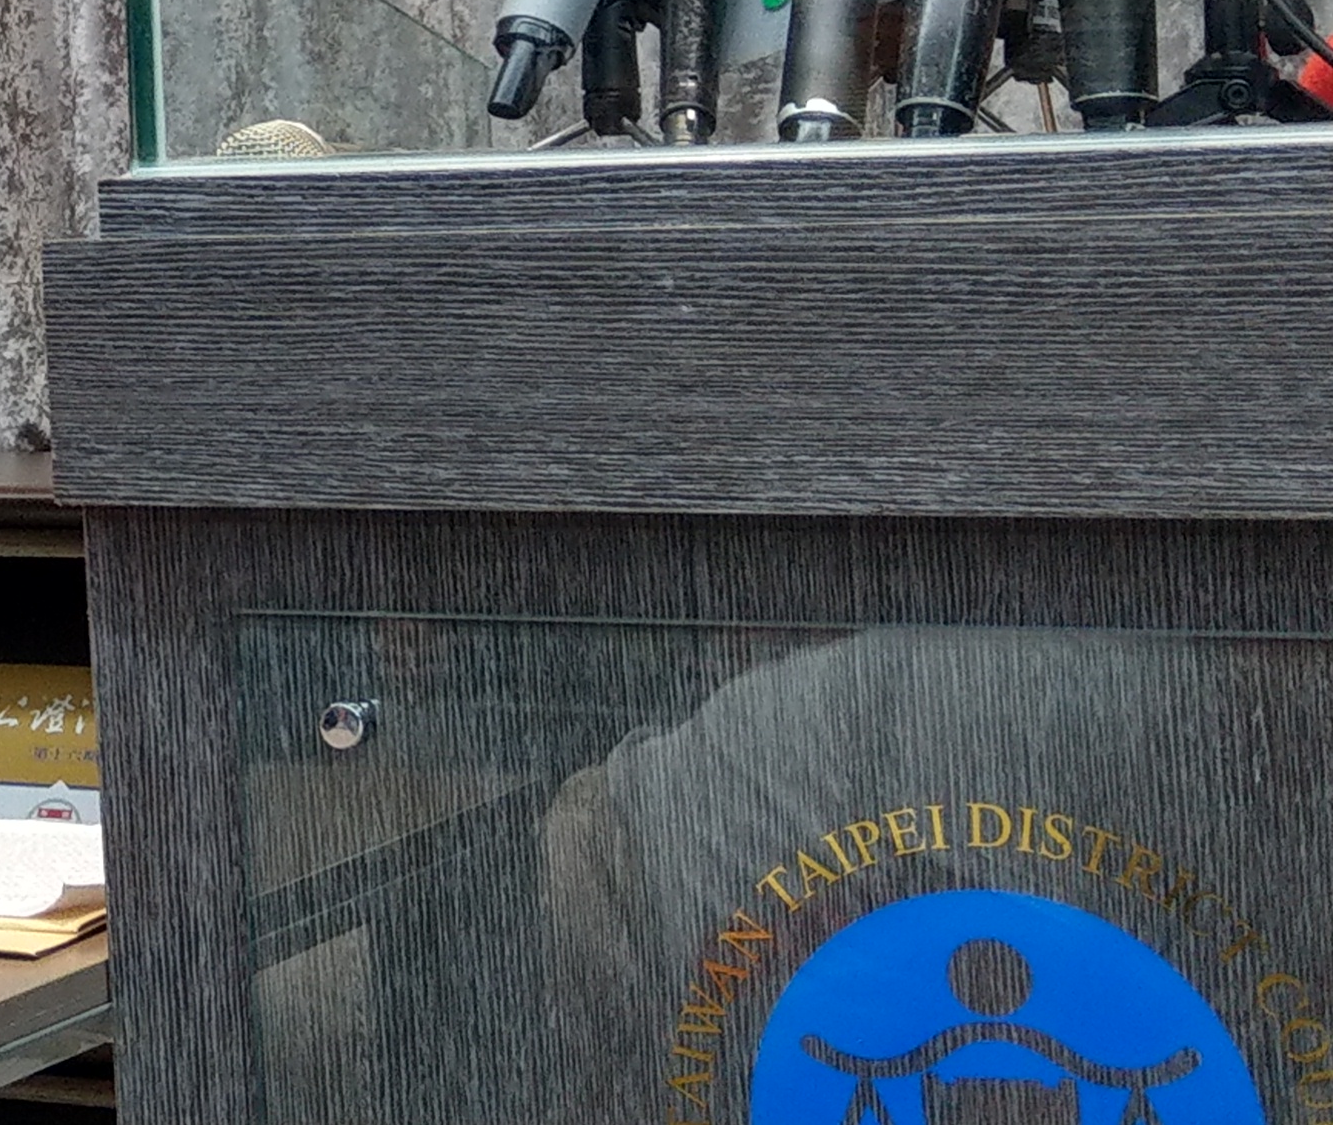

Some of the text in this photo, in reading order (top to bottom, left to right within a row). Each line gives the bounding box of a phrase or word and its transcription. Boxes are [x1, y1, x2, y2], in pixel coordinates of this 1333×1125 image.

[756, 804, 950, 913] TAIPEI
[966, 802, 1269, 964] DISTRICT
[1257, 972, 1333, 1125] COU
